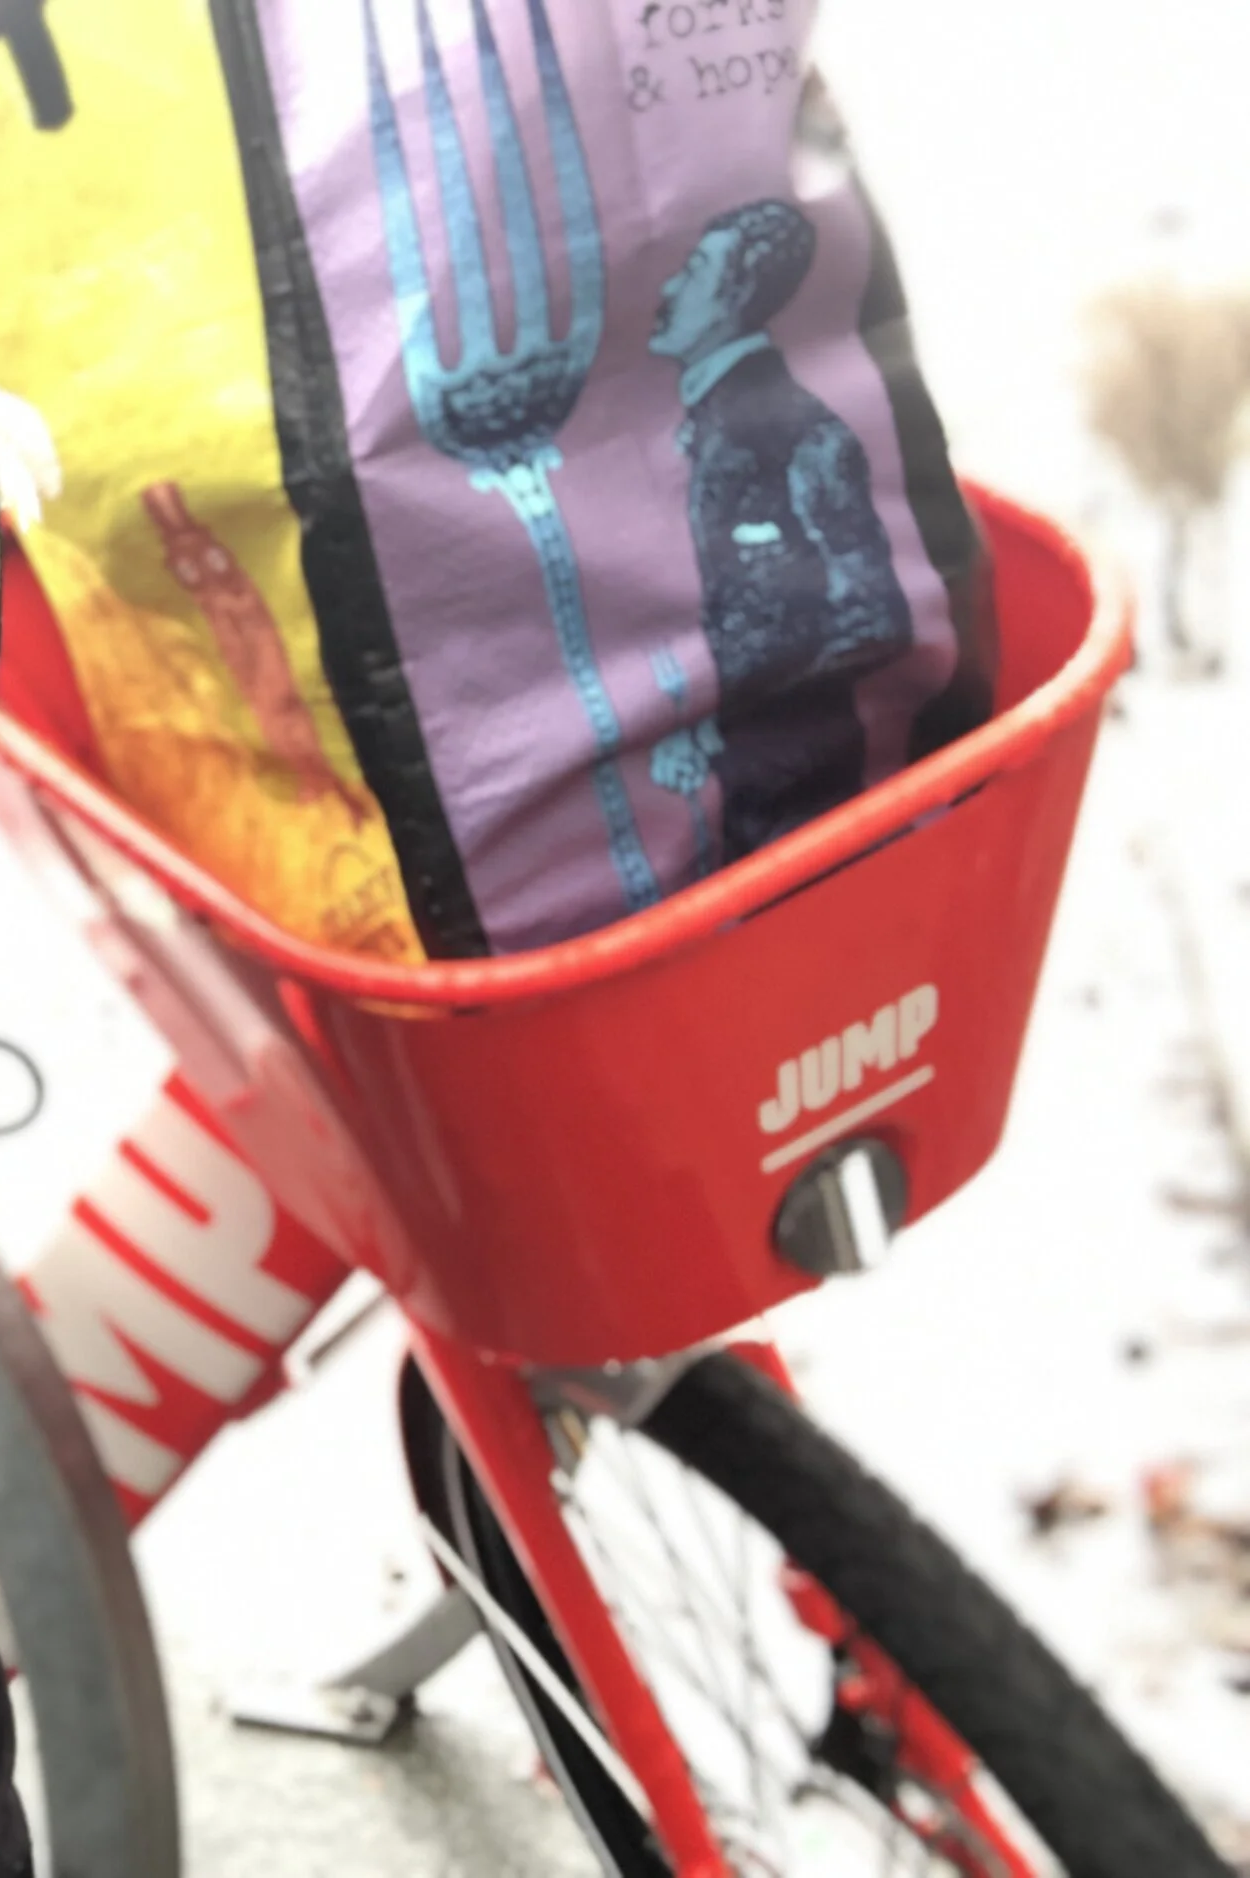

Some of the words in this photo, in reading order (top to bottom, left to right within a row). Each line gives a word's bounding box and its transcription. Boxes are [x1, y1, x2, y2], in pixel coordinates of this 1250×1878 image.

[627, 65, 665, 113] &
[758, 983, 939, 1135] JUMP
[26, 1085, 313, 1498] MP
